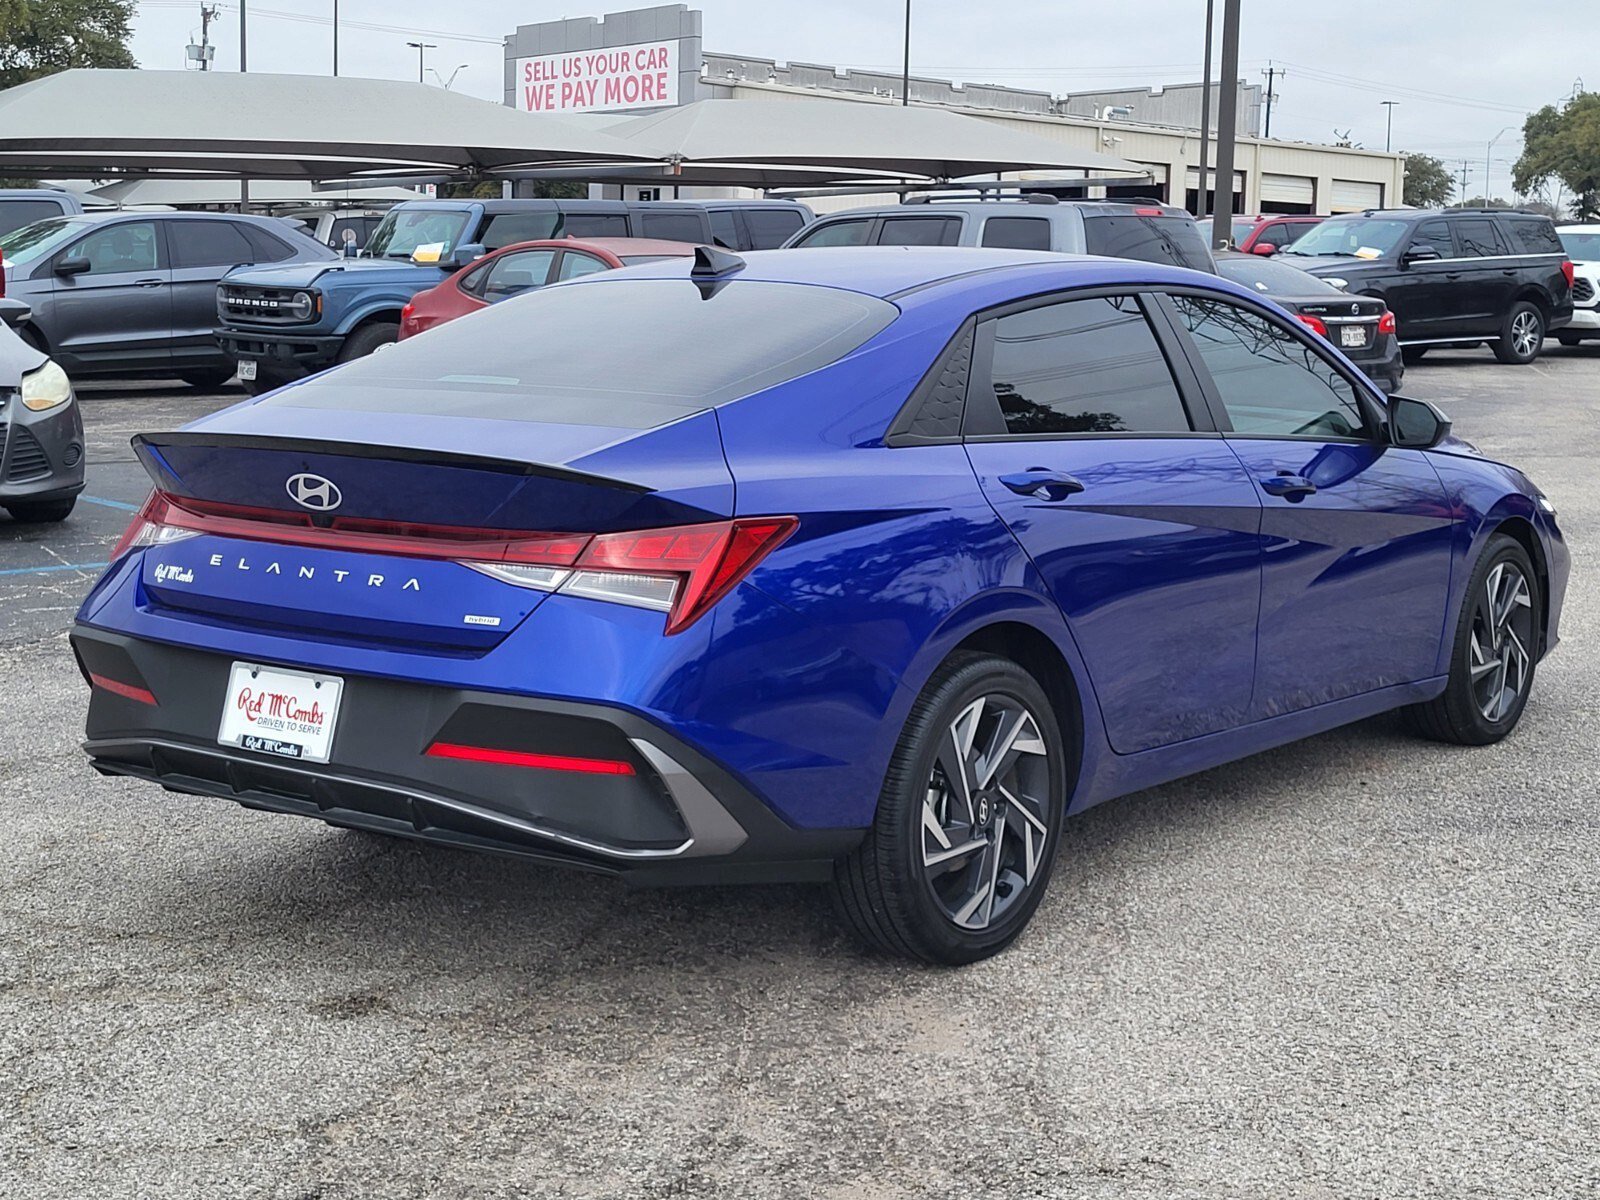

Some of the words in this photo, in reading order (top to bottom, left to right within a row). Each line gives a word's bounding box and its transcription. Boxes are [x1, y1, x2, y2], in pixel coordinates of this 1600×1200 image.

[525, 60, 558, 82] SELL
[562, 58, 582, 78] US
[585, 52, 630, 75] YOUR
[635, 47, 668, 70] CAR
[525, 83, 555, 111] WE
[561, 79, 598, 108] PAY
[604, 72, 667, 105] MORE
[228, 297, 278, 307] BRONCO
[209, 553, 421, 592] ELANTRA
[238, 687, 265, 721] Red
[257, 716, 285, 730] DRIVEN
[286, 721, 297, 731] TO
[298, 724, 322, 736] SERVE
[245, 736, 262, 751] Red
